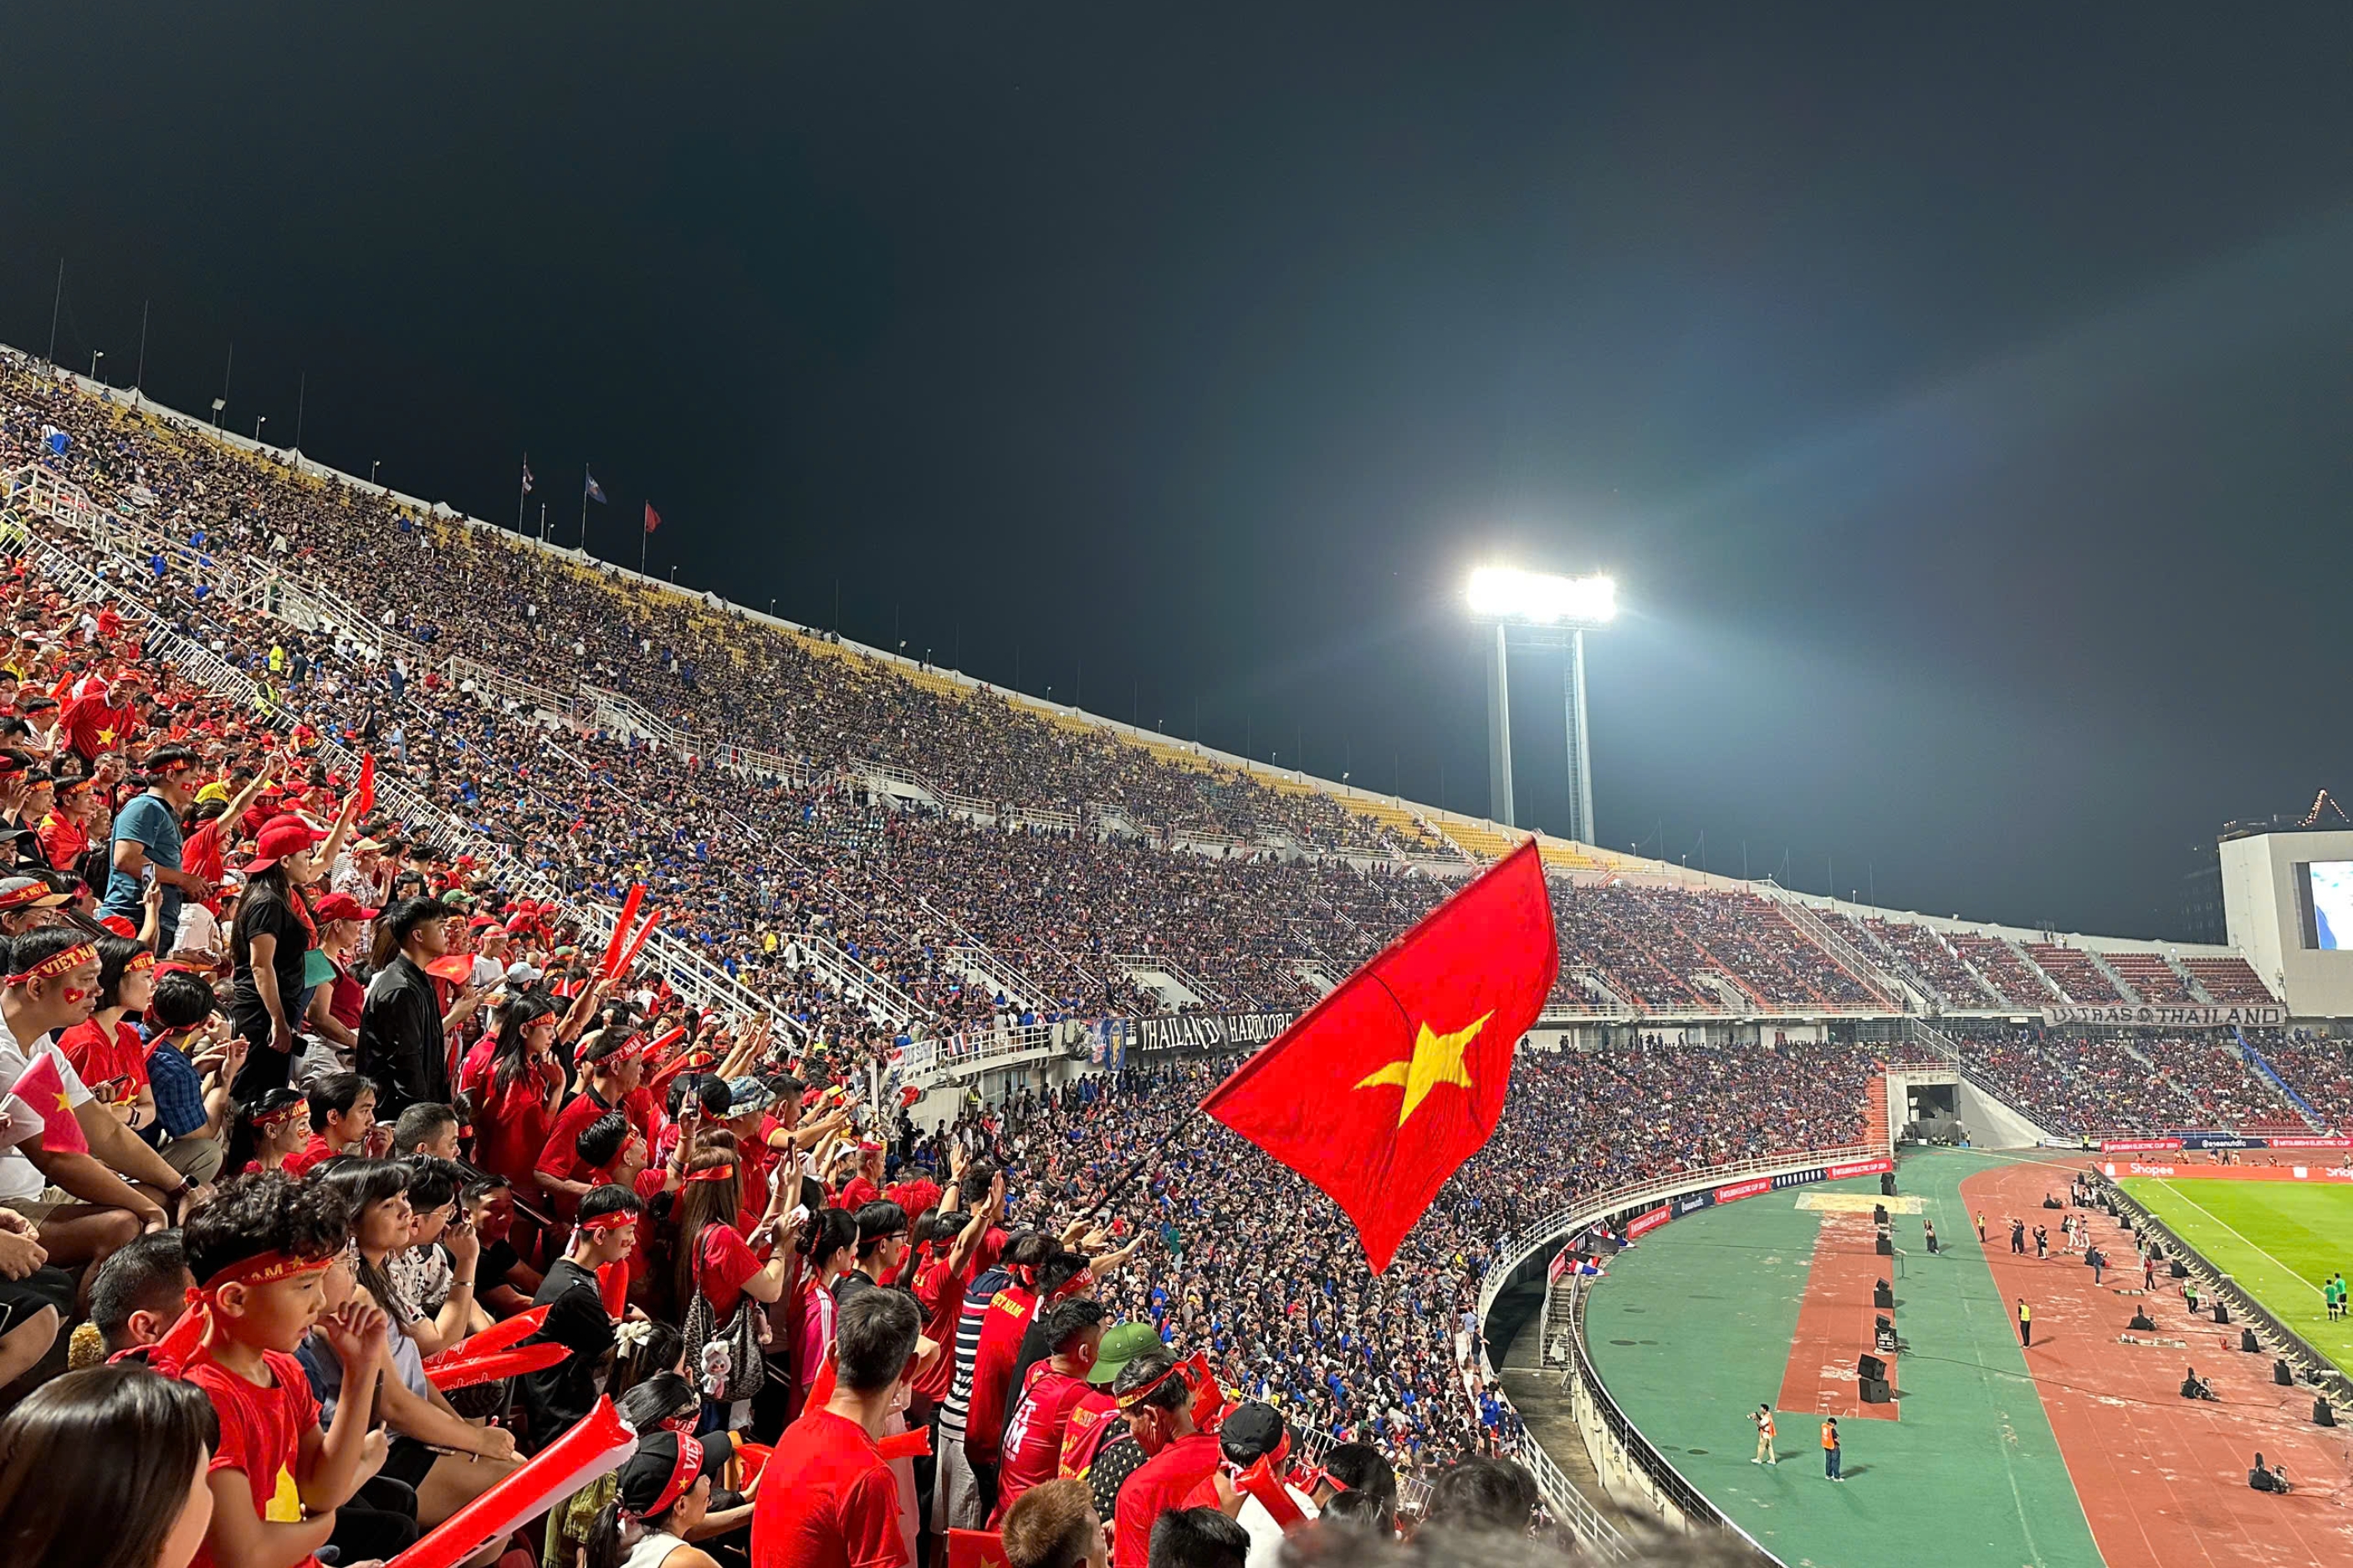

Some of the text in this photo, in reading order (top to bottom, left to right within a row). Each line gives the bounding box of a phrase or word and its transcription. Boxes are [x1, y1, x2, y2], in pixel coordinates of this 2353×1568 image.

[41, 943, 98, 973] VIỆT NA
[2156, 1009, 2279, 1023] THAILAND
[1142, 1015, 1220, 1051] THAILAND
[2130, 1162, 2175, 1177] Shopee
[251, 1263, 284, 1280] AM
